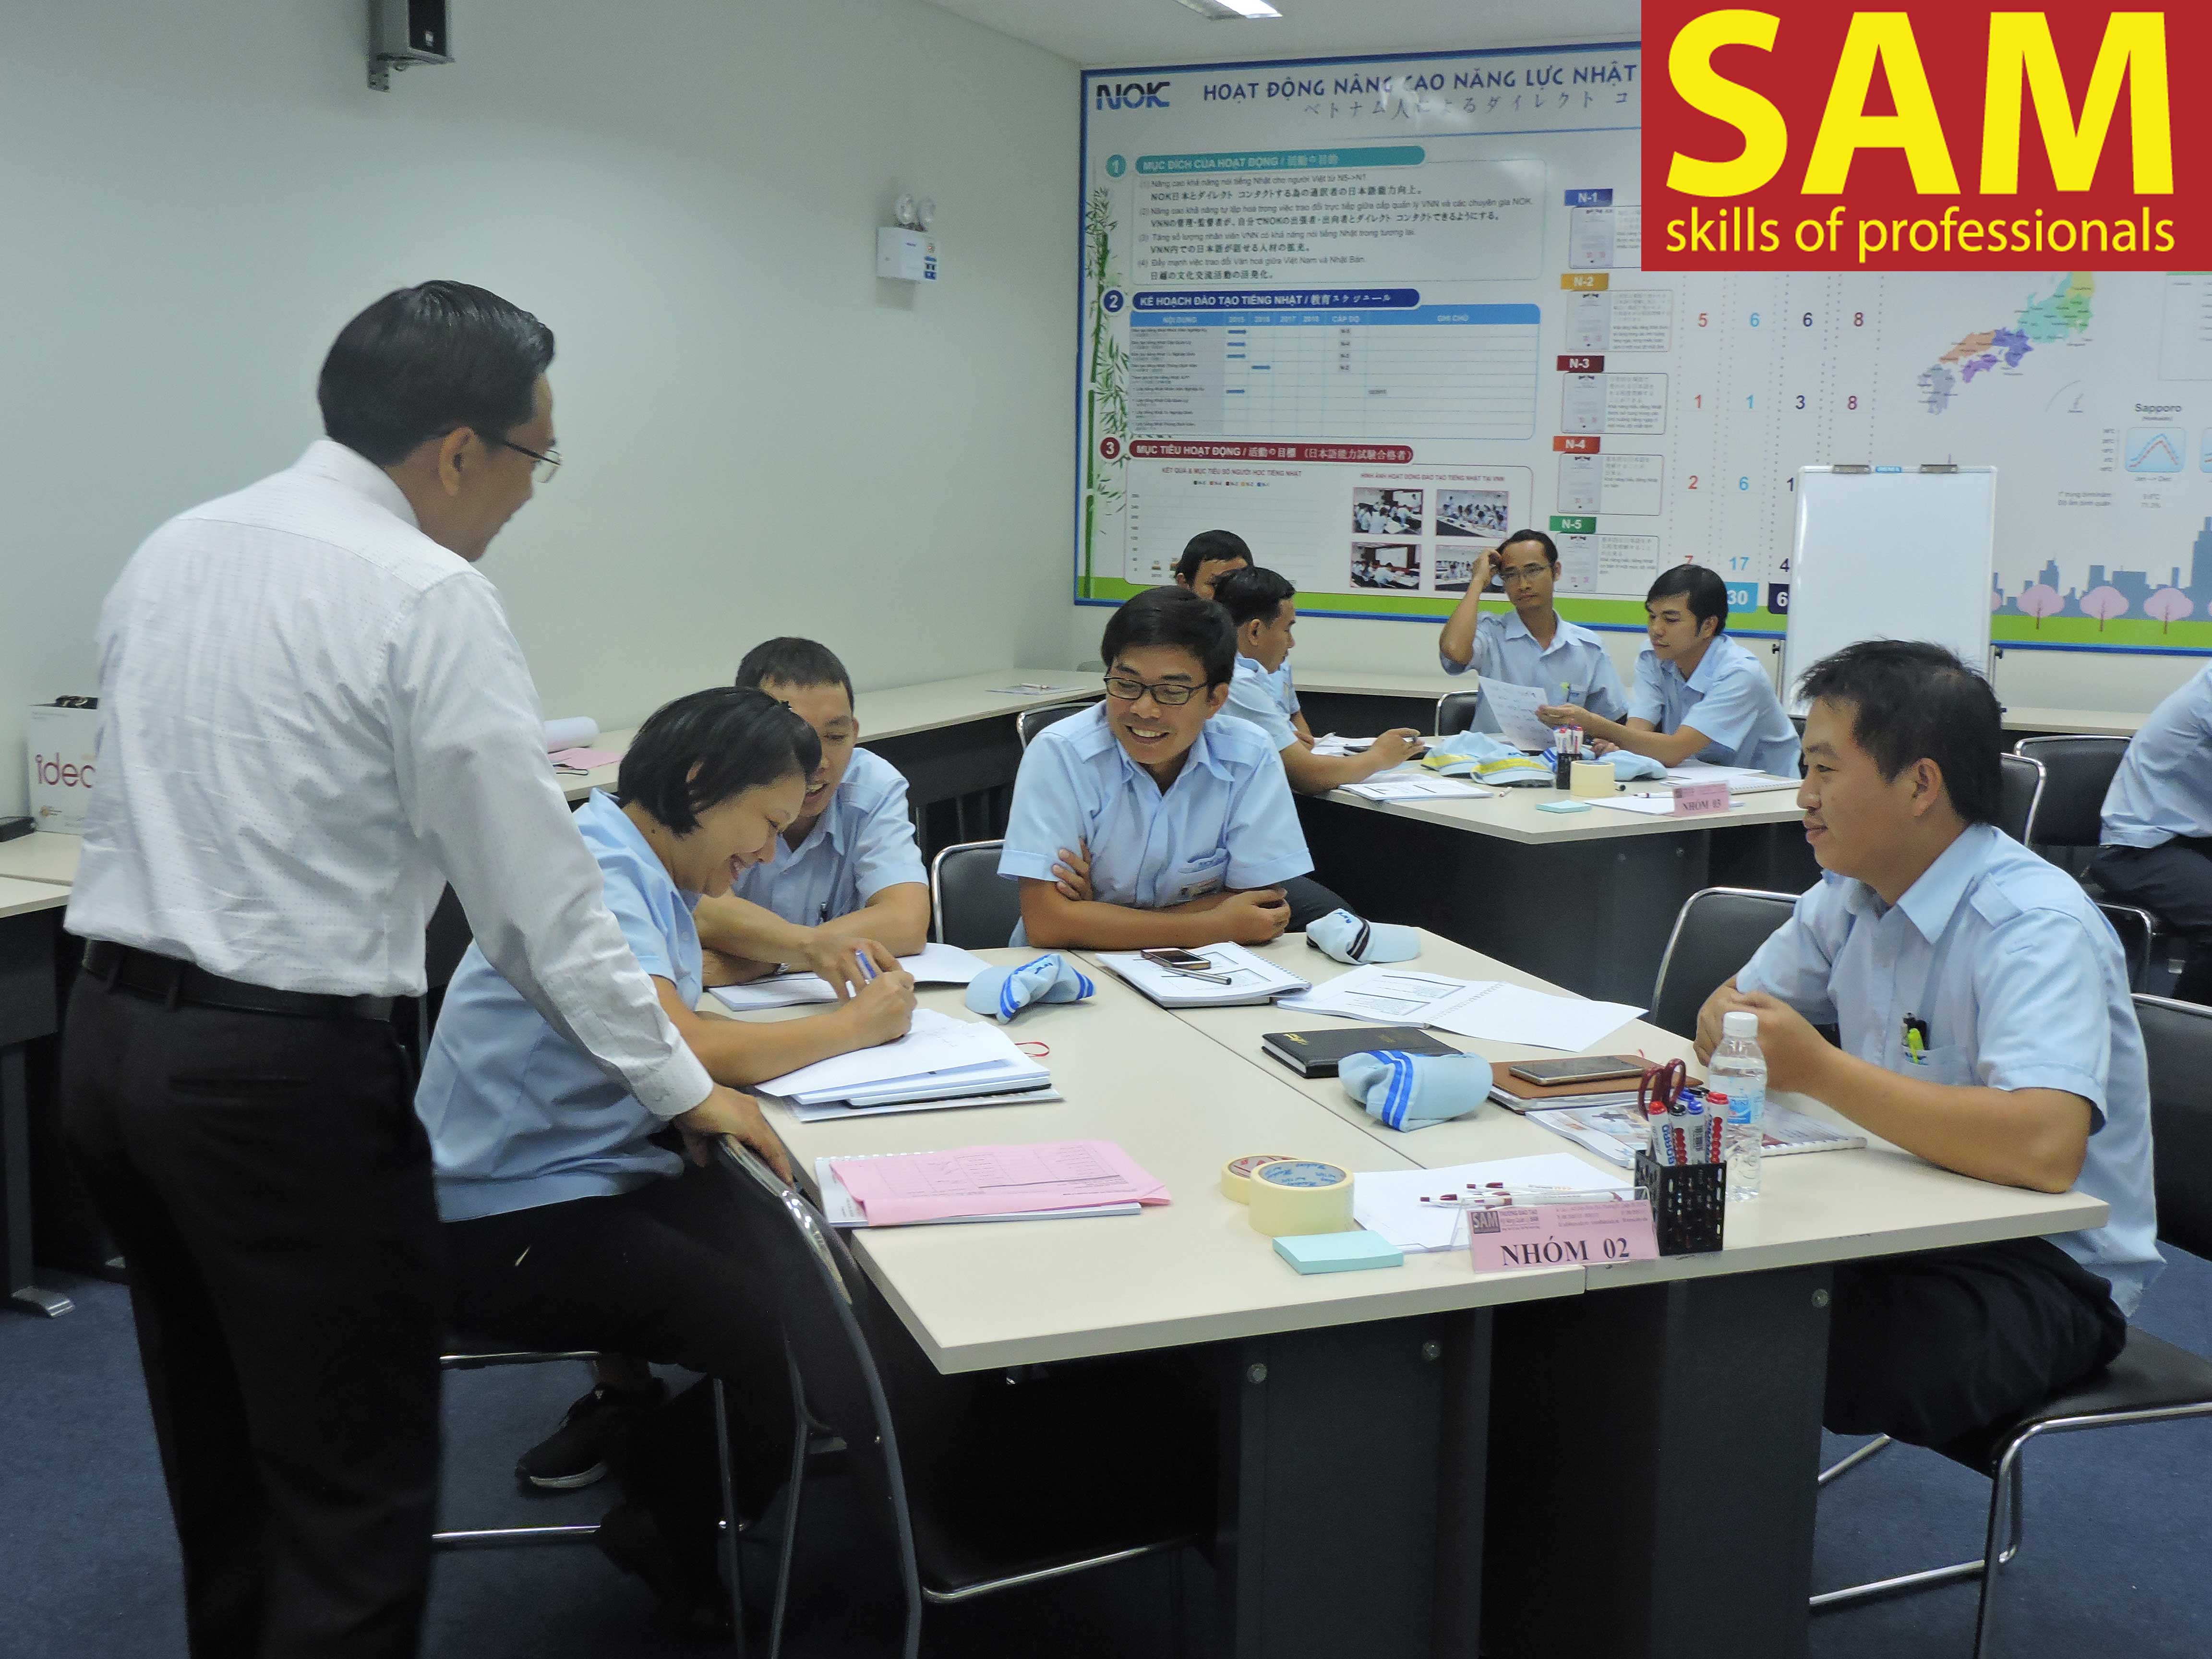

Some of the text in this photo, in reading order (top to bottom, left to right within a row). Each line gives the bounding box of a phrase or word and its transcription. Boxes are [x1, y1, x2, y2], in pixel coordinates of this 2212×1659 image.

[1203, 83, 1259, 104] HOẠT
[1267, 76, 1324, 101] ĐỘNG
[1454, 68, 1515, 89] NĂNG
[1526, 65, 1563, 91] LỰC
[1573, 60, 1637, 87] NHẬT
[1096, 82, 1170, 110] NOK
[1112, 160, 1119, 173] 1
[1577, 192, 1598, 203] N-1
[1573, 276, 1594, 287] N-2
[1109, 295, 1118, 308] 2
[1156, 297, 1191, 308] HOẠCH
[1218, 296, 1239, 307] TẠO
[1698, 313, 1708, 327] 5
[1750, 313, 1760, 327] 6
[1803, 312, 1813, 327] 6
[1854, 312, 1864, 327] 8
[1569, 358, 1590, 369] N-3
[1694, 394, 1702, 409] 1
[1746, 394, 1754, 409] 1
[1795, 395, 1805, 409] 3
[1847, 395, 1858, 410] 8
[2135, 404, 2182, 414] Sapporo
[1106, 442, 1115, 455] 3
[1565, 439, 1586, 449] N-4
[1688, 475, 1698, 490] 2
[1739, 476, 1749, 491] 6
[1561, 520, 1582, 529] N-5
[1729, 556, 1750, 571] 17
[1779, 558, 1790, 572] 4
[1727, 590, 1748, 605] 30
[1473, 1211, 1500, 1228] SAM
[1501, 1236, 1630, 1266] NHÓM 02
